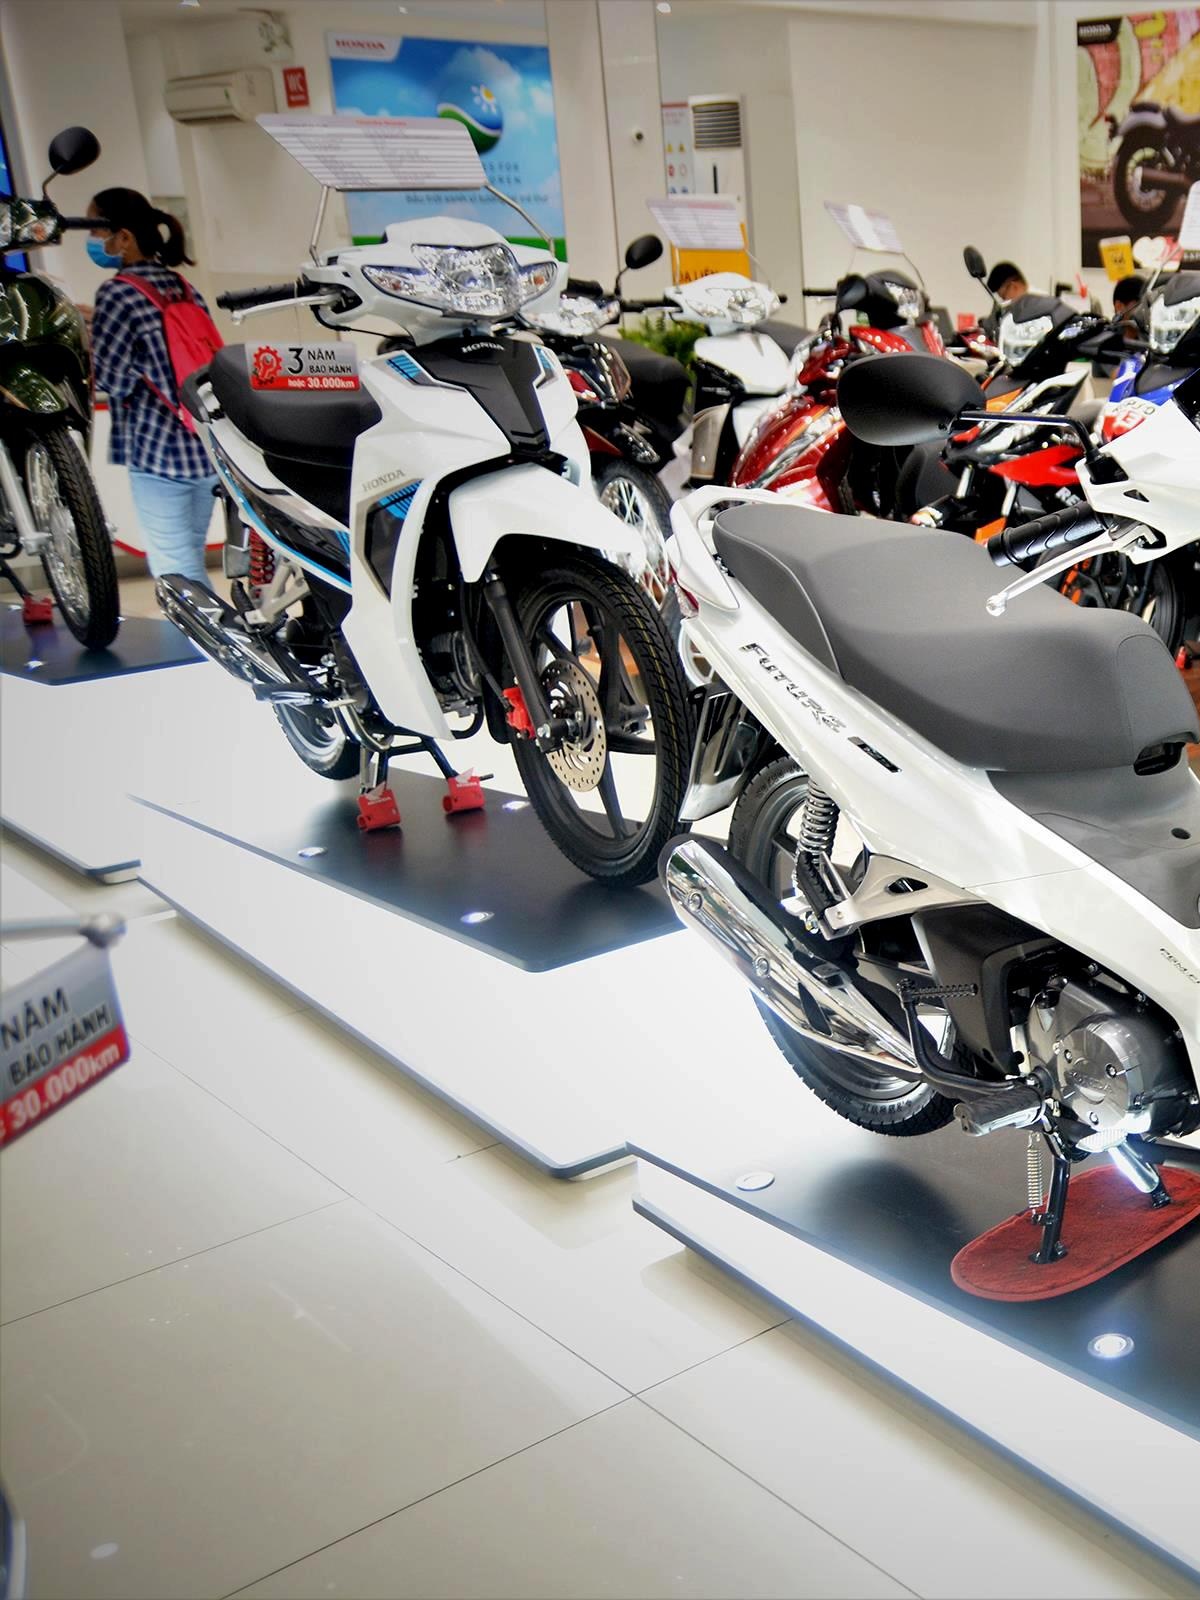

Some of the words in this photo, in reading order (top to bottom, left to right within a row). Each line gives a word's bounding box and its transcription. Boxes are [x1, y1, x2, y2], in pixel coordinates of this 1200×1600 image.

[335, 39, 385, 50] HONDA
[461, 341, 505, 353] HONDA
[287, 347, 304, 374] 3
[307, 377, 356, 389] 30.000km
[362, 469, 406, 491] HONDA
[8, 1043, 121, 1130] 30.000km
